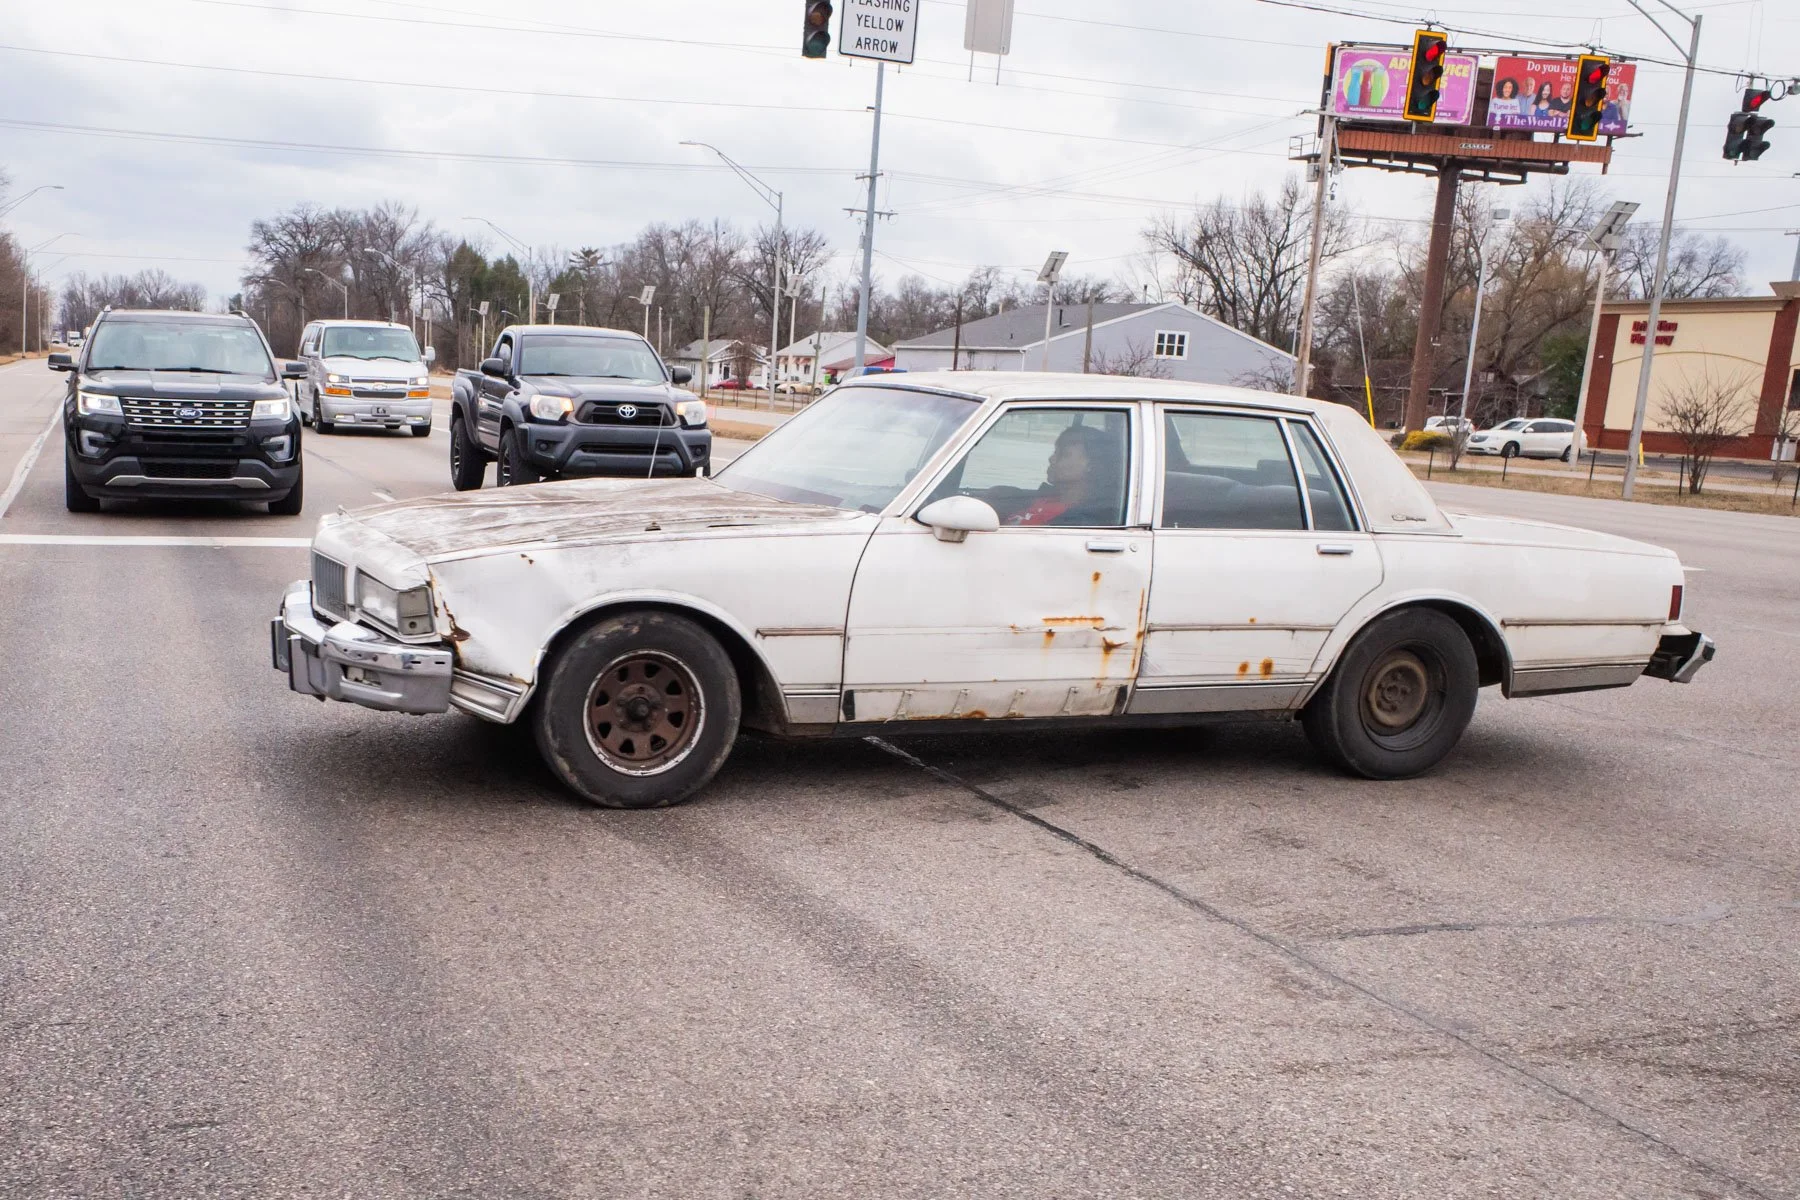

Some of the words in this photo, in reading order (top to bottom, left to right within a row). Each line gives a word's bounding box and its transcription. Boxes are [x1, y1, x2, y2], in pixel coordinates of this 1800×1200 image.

[851, 0, 911, 12] ASHING
[856, 13, 904, 32] YELLOW
[855, 36, 898, 53] ARROW
[1526, 61, 1540, 71] Do
[1541, 62, 1560, 74] you
[1561, 63, 1577, 74] kn
[1560, 74, 1572, 82] He
[1493, 102, 1510, 110] Tune
